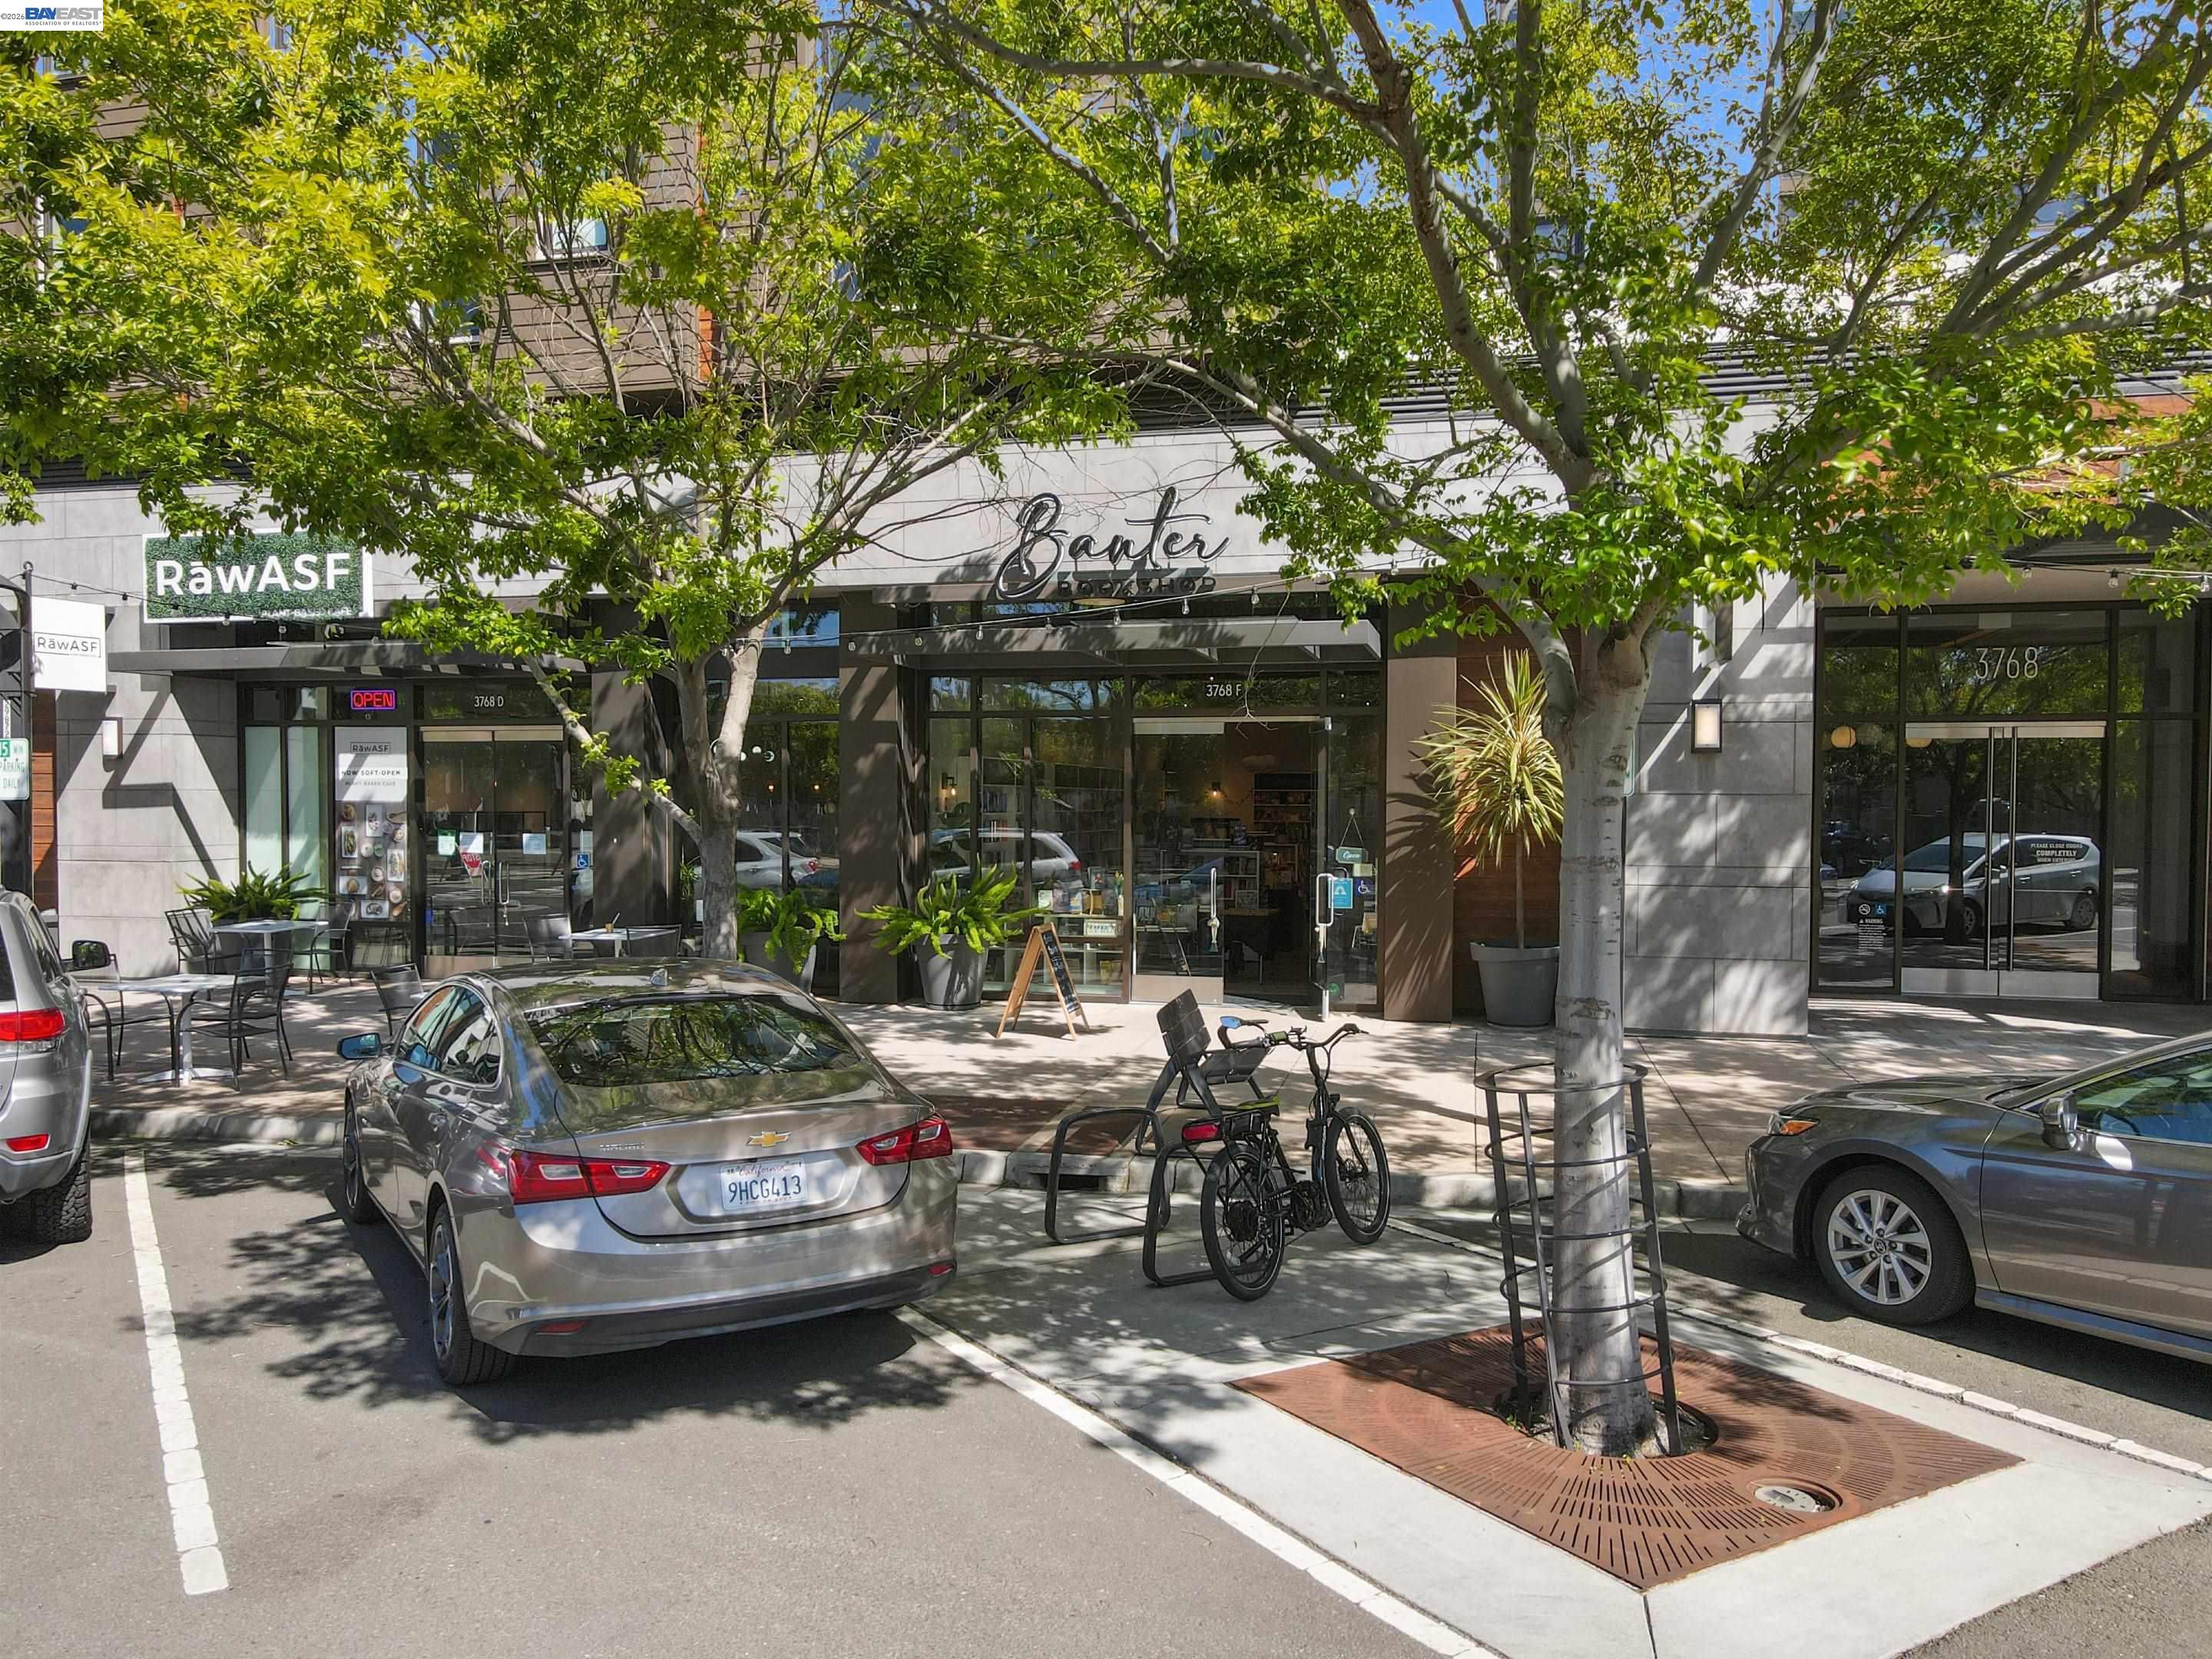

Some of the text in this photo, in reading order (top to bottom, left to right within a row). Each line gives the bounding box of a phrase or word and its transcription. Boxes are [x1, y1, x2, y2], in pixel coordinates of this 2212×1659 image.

[995, 485, 1232, 601] Banter
[155, 551, 350, 596] RāwASF
[1057, 576, 1217, 598] BOOKSHOP
[37, 636, 98, 652] RāwASF
[1975, 647, 2038, 679] 3768
[353, 692, 393, 707] OPEN
[473, 696, 504, 707] 3768 D
[1206, 684, 1242, 697] 3768 F
[728, 1175, 801, 1203] 9HCG413
